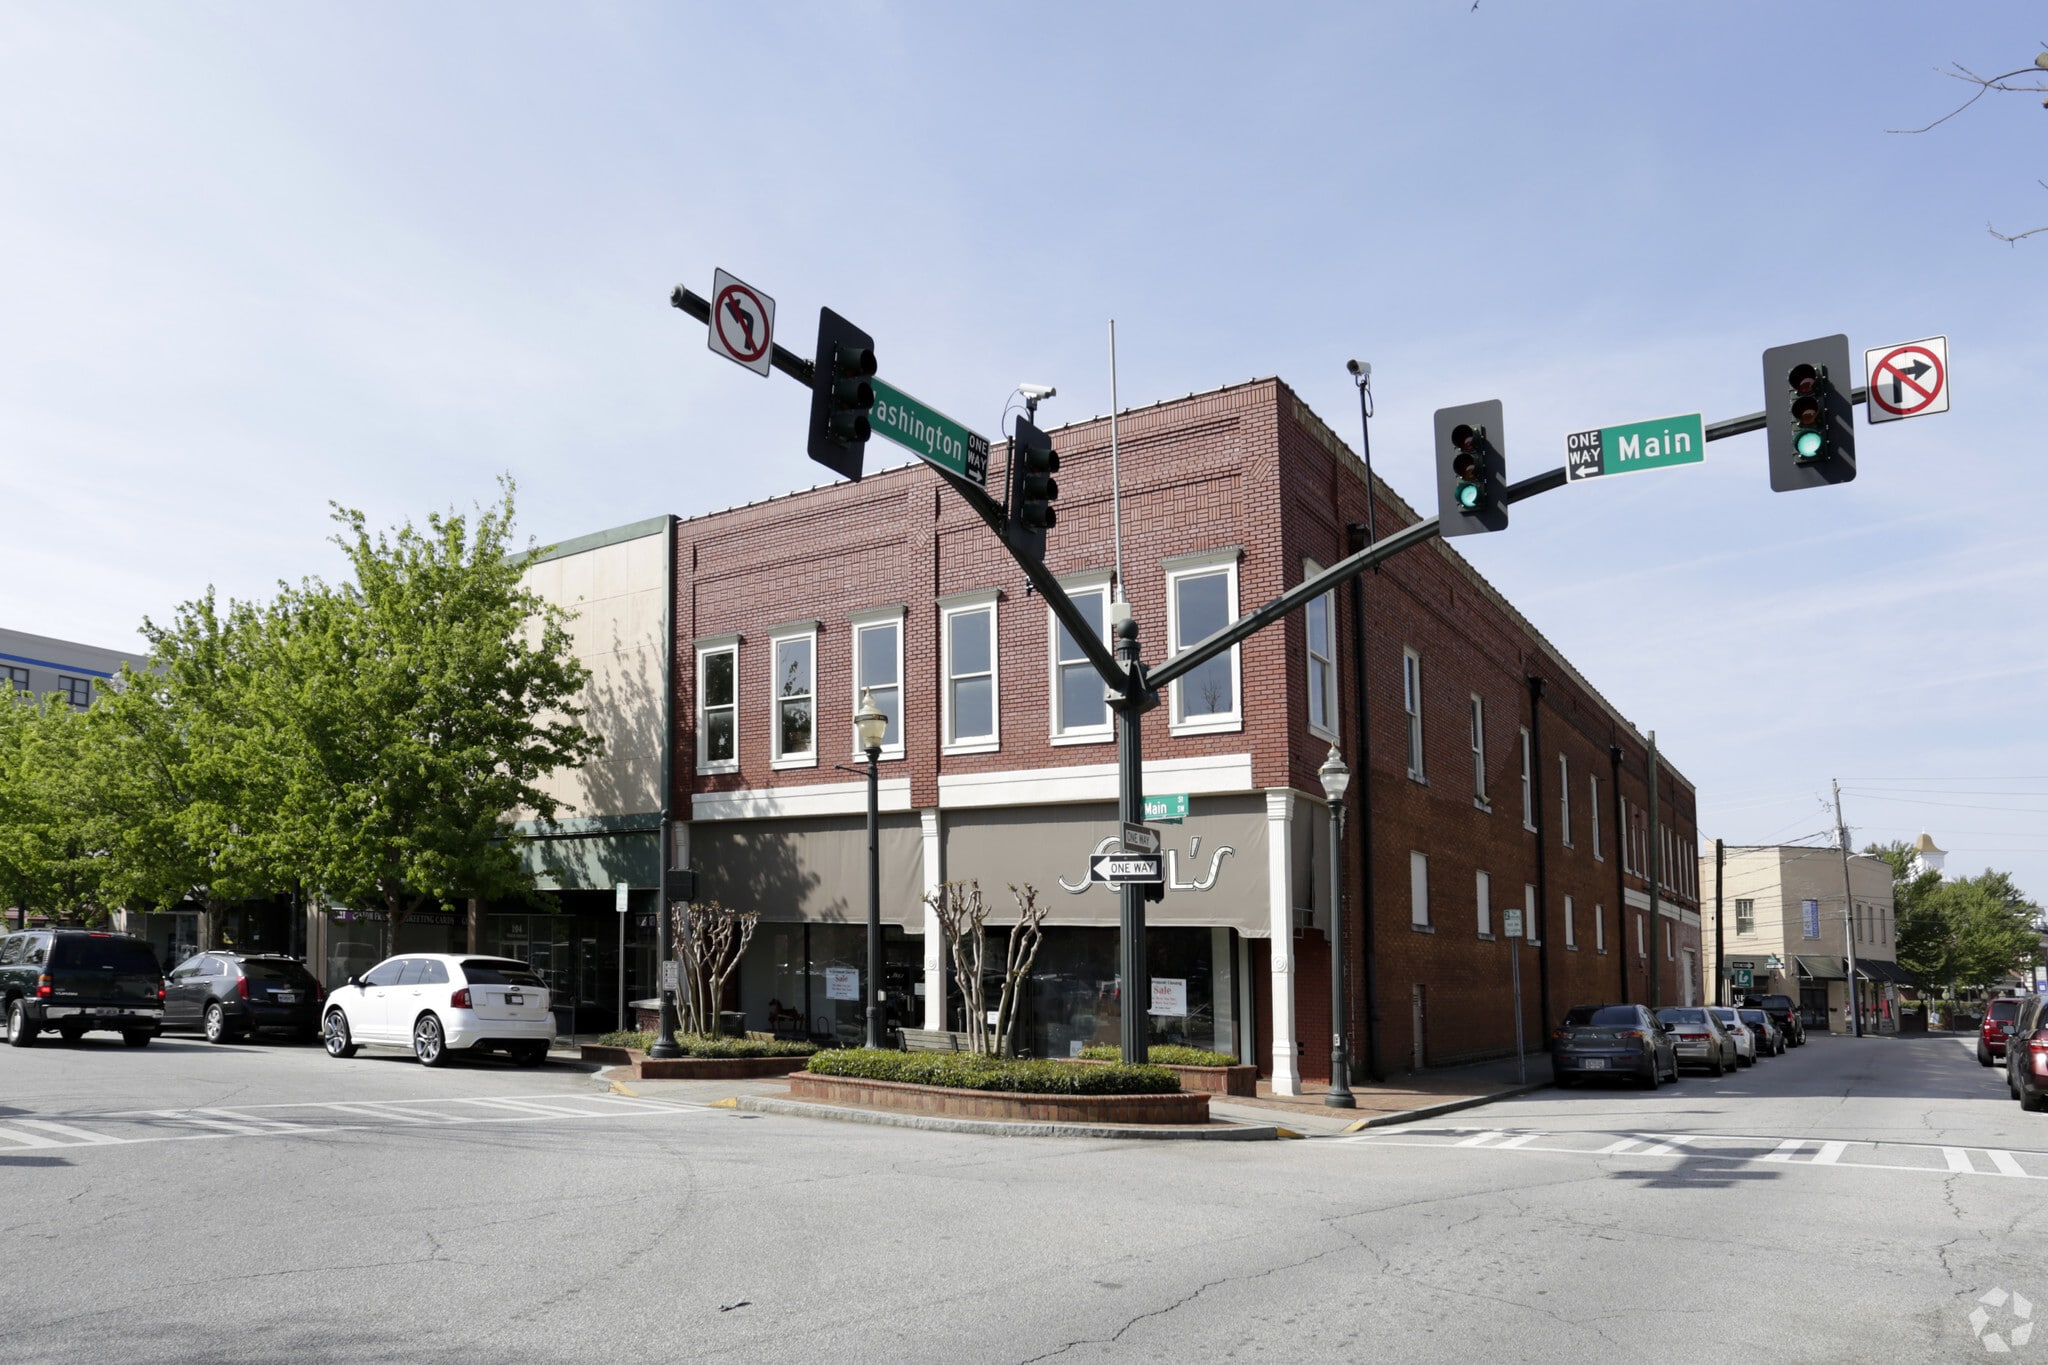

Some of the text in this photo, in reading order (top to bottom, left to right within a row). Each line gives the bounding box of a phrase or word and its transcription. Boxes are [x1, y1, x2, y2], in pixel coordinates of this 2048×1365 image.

[869, 390, 962, 461] ashington
[969, 435, 988, 455] ONE
[1569, 432, 1599, 448] ONE
[1618, 429, 1691, 462] Main
[967, 453, 987, 471] WAY
[1569, 448, 1600, 465] WAY
[1144, 801, 1167, 816] Main
[1127, 831, 1150, 846] ONE WAY
[1111, 862, 1154, 873] ONE WAY
[1153, 985, 1172, 995] Sale
